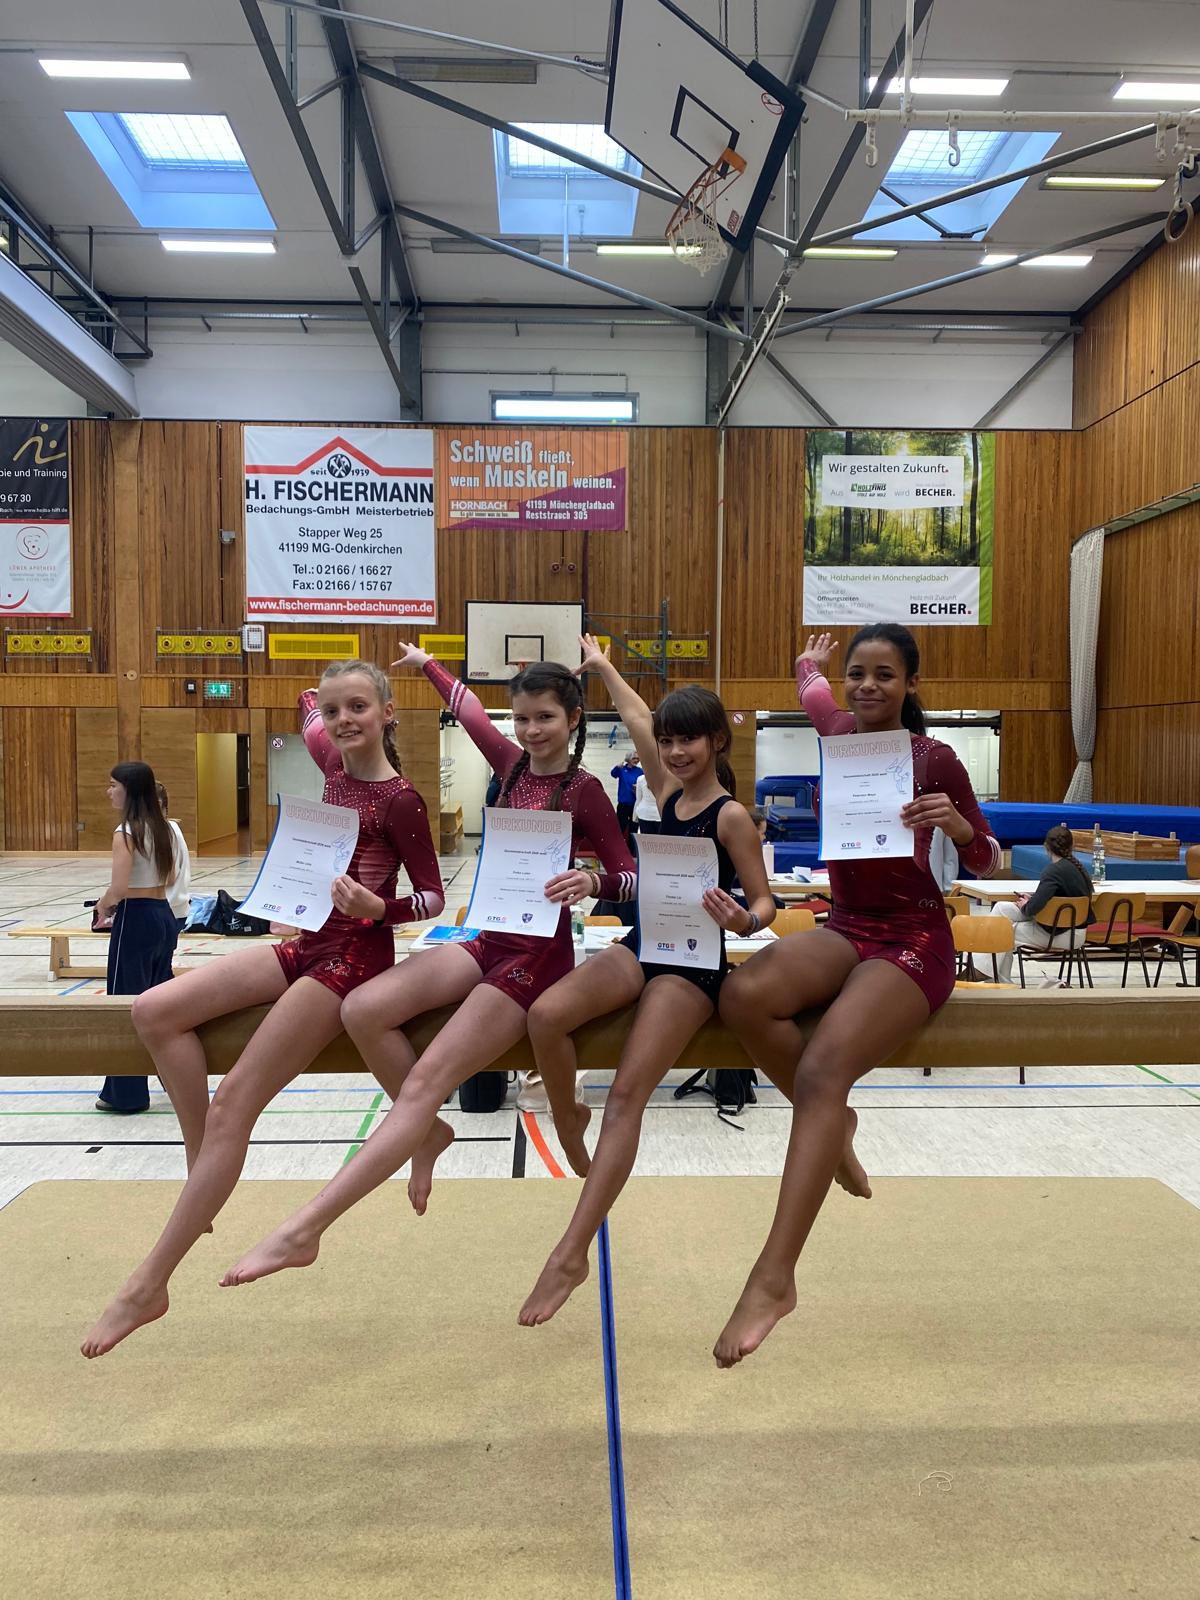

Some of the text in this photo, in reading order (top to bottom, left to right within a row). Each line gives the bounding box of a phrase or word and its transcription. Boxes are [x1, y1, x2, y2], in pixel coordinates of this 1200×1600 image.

[450, 440, 575, 465] Schweiß fließt,
[14, 468, 31, 477] und
[33, 468, 68, 479] Training
[310, 468, 370, 476] seit 1939
[829, 463, 949, 475] Wir gestalten Zukunft.
[450, 465, 617, 489] wenn Muskeln weinen.
[245, 479, 434, 503] H. FISCHERMANN
[894, 488, 910, 496] wird
[915, 488, 956, 497] BECHER.
[246, 504, 434, 517] Bedachungs-GmbH Meisterbetrieb
[451, 500, 507, 510] HORNBACH
[525, 500, 615, 511] 41199 Mönchengladbach
[525, 511, 588, 520] Reststrauch 305
[298, 527, 383, 540] Stapper Weg 25
[278, 543, 403, 555] 41199 MG-Odenkirchen
[293, 580, 315, 590] Fax:
[249, 600, 433, 614] www.fischermann-bedachungen.de
[910, 603, 972, 615] BECHER.
[828, 740, 901, 759] URKUNDE
[285, 804, 352, 830] URKUNDE
[491, 816, 562, 834] URKUNDE
